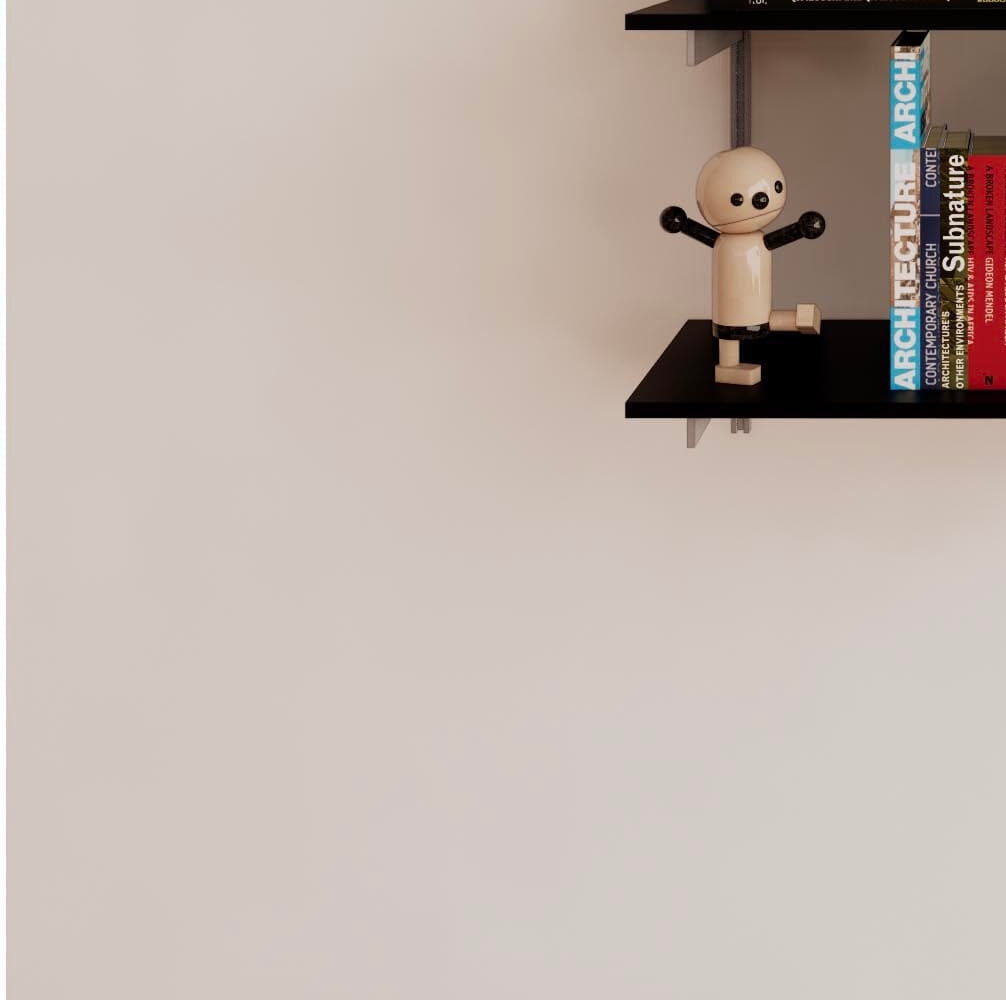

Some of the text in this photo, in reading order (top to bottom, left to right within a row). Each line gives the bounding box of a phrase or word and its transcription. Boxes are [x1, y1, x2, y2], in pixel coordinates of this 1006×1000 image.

[894, 46, 917, 144] ARCHI
[925, 148, 937, 188] CONTE
[984, 173, 994, 205] BROKEN
[941, 154, 965, 272] Subnature
[984, 208, 994, 255] LANDSCAPE
[893, 162, 917, 391] ARCHITECTURE
[984, 257, 994, 289] GIDEON
[984, 290, 994, 323] MENDEL
[925, 243, 937, 386] CONTEMPORARY CHURCH
[941, 311, 950, 389] ARCHITECTURE'S
[955, 285, 965, 389] OTHER ENVIRONMENTS
